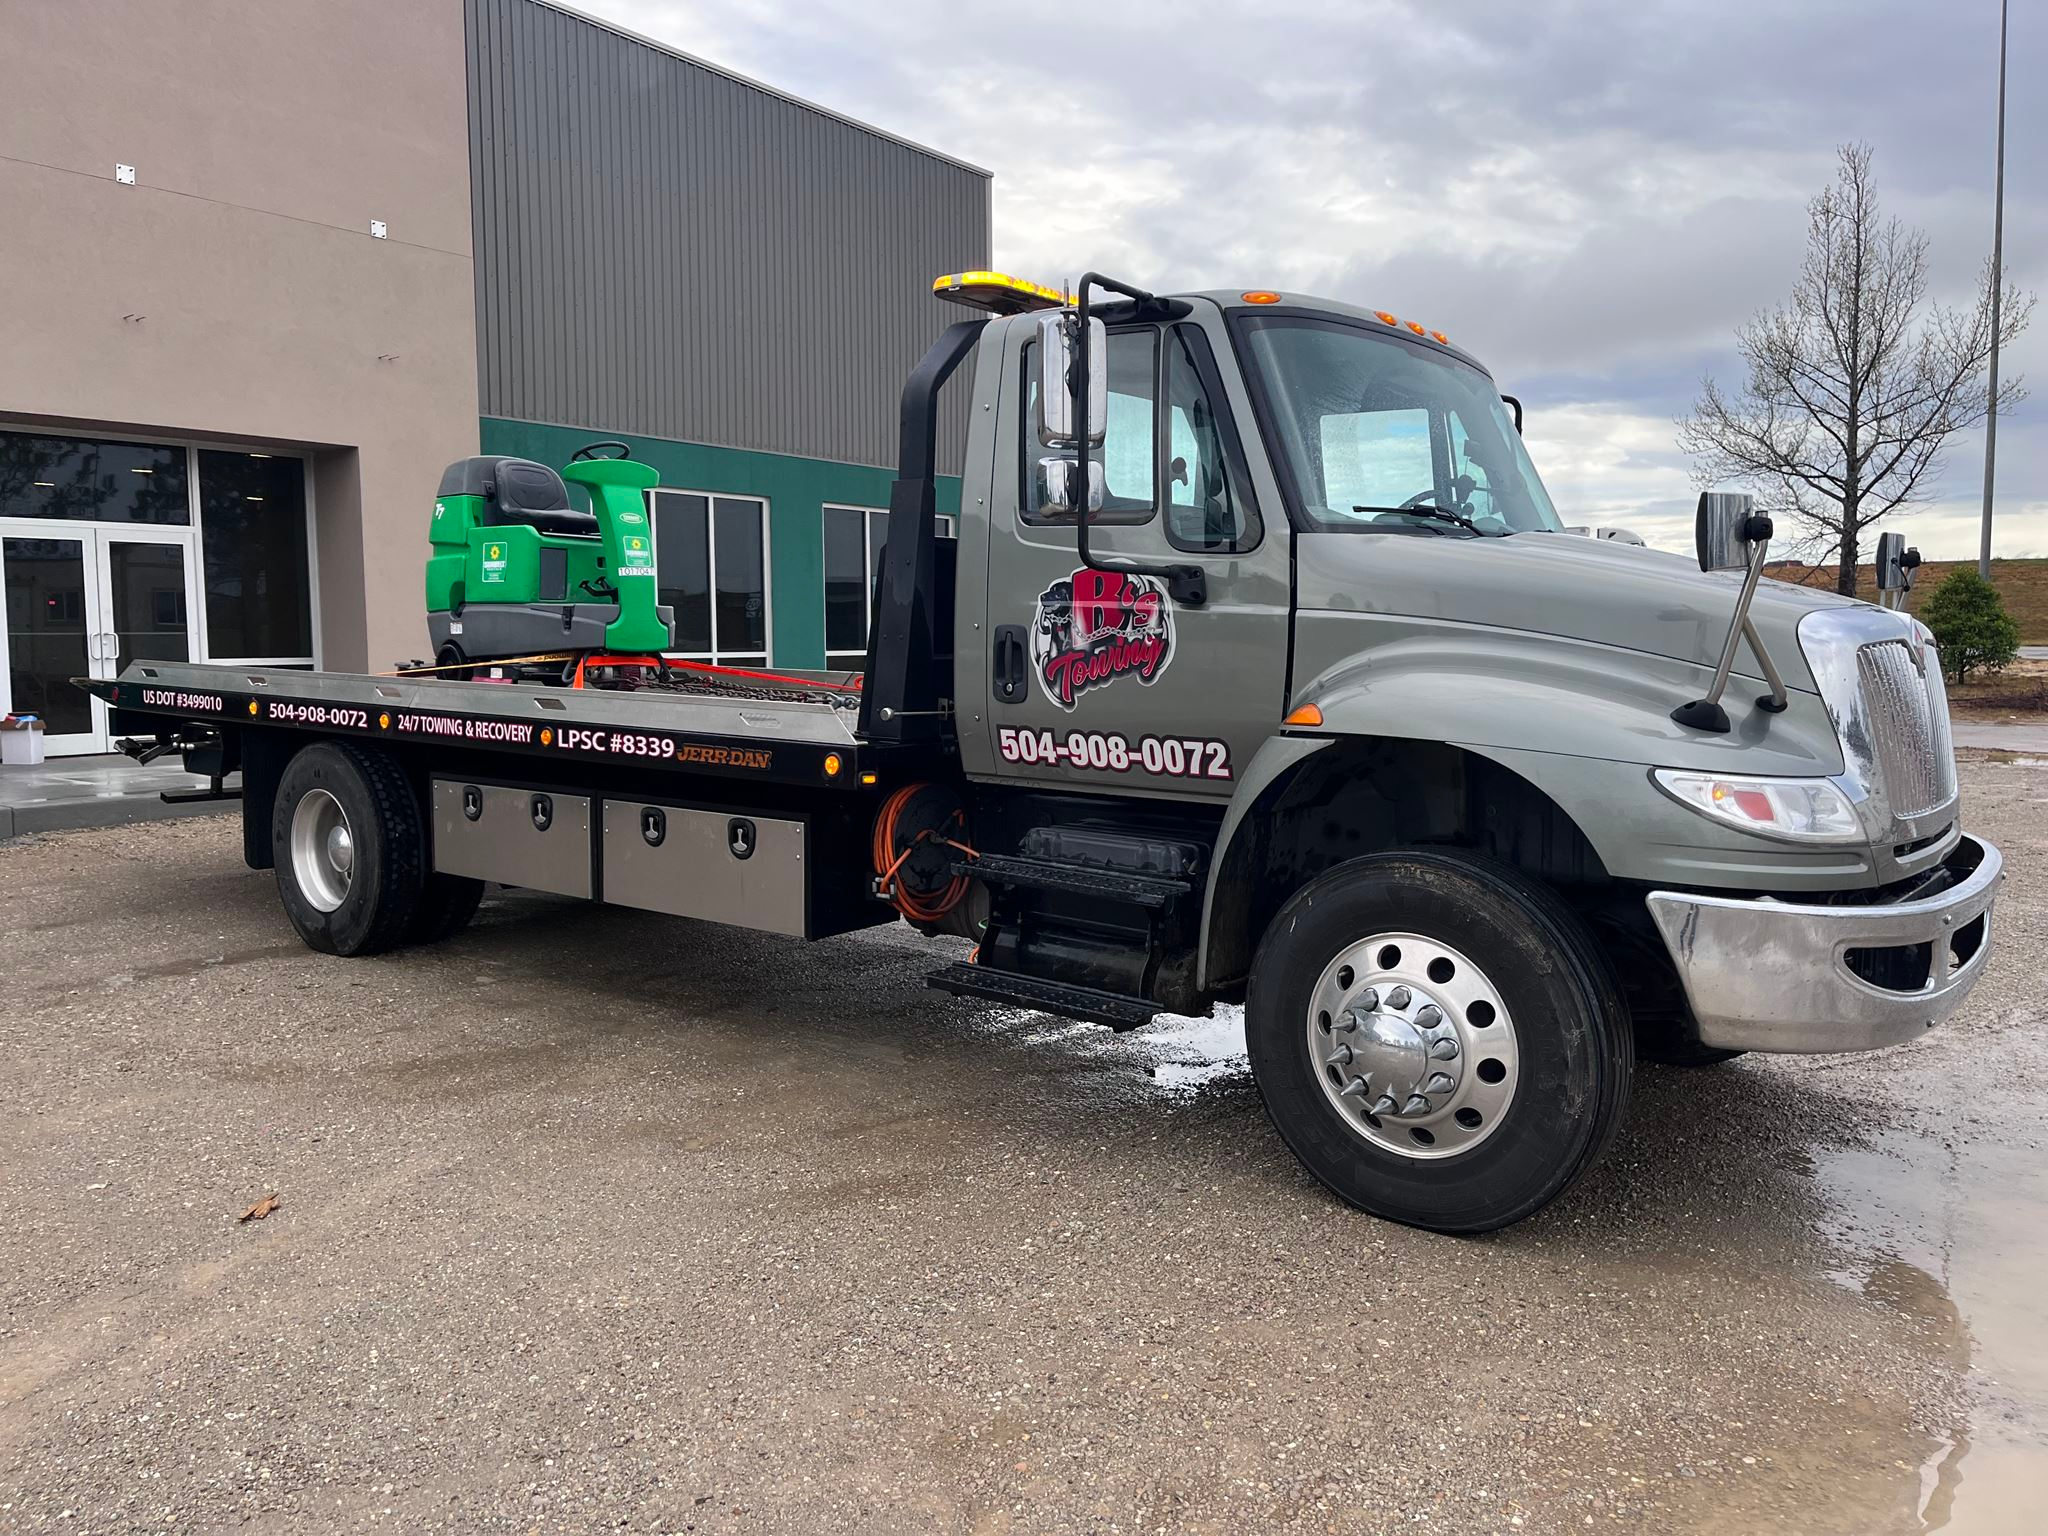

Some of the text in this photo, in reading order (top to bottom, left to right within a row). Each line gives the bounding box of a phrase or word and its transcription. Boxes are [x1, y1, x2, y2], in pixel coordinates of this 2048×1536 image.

[1046, 635, 1166, 702] Towing
[143, 690, 222, 711] US DOT #3499010
[269, 703, 367, 727] 504-908-0072
[398, 714, 532, 743] 24/7 TOWING & RECOVERY
[557, 729, 674, 757] LPSC #8339
[998, 728, 1230, 777] 504-908-0072
